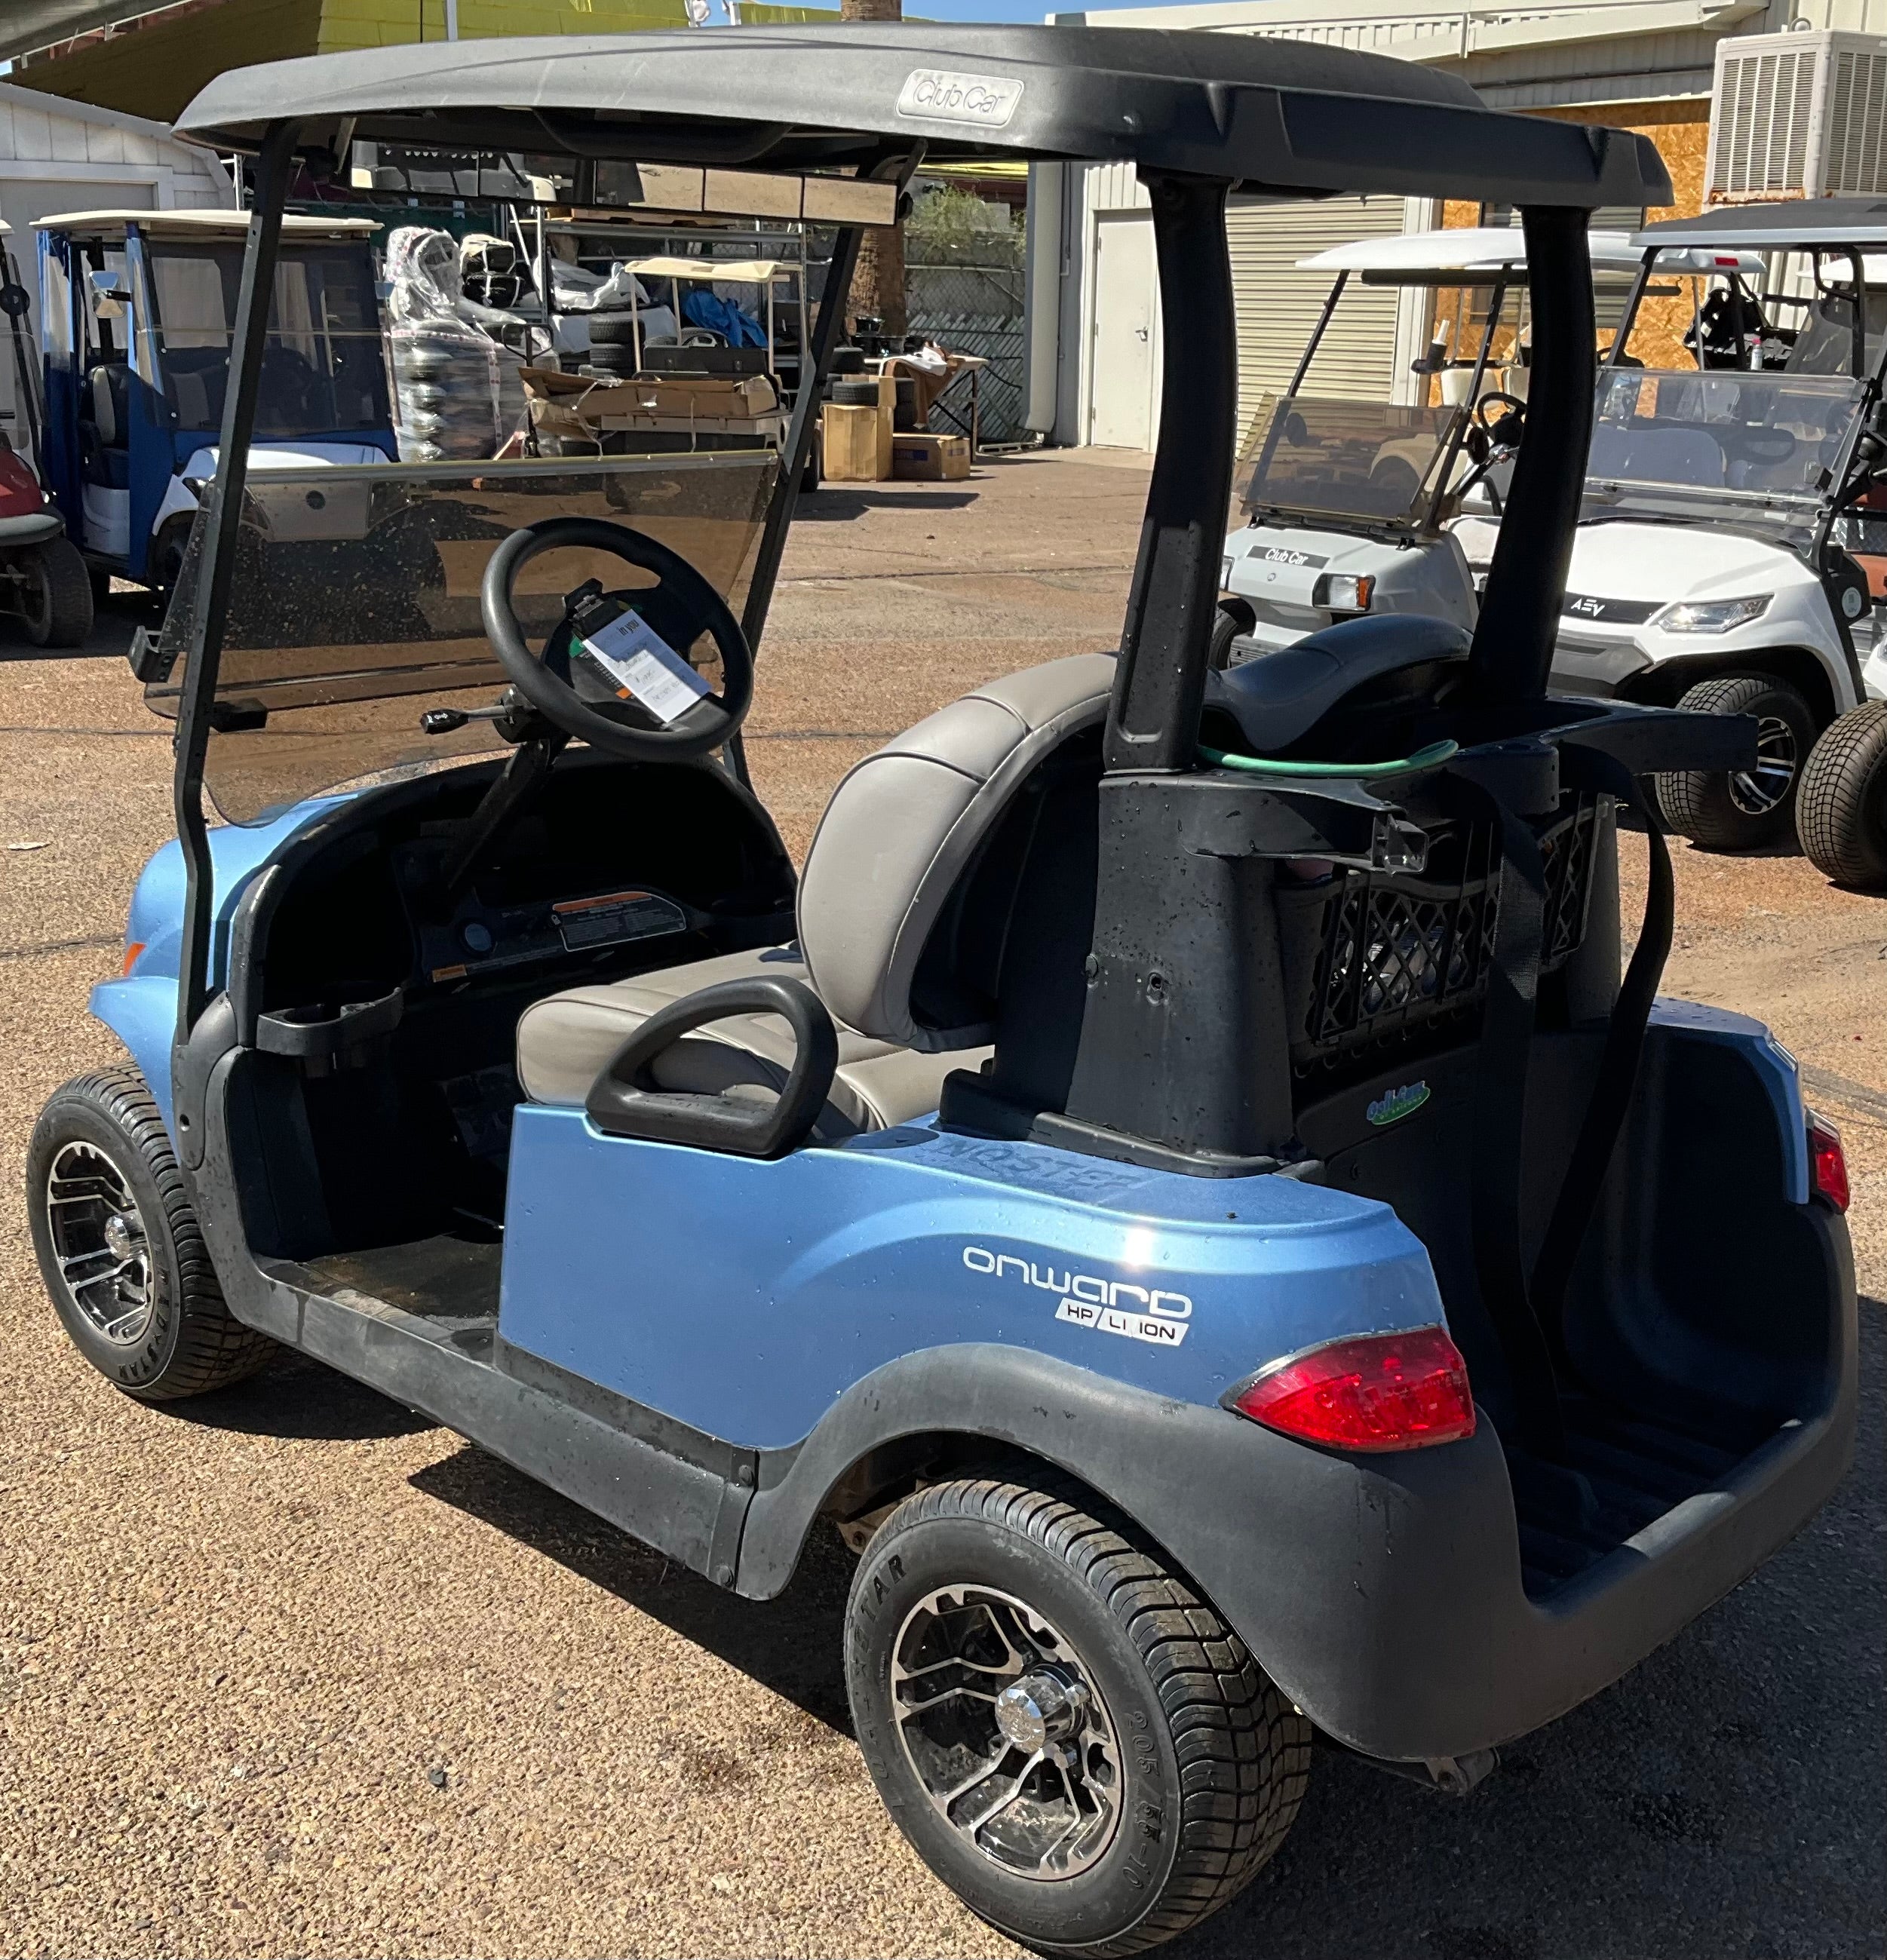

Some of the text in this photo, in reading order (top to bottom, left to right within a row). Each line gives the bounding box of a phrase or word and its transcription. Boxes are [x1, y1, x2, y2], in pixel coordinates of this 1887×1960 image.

[913, 79, 1007, 114] Club Car
[1265, 548, 1309, 566] Club Car
[1570, 597, 1606, 617] AEV
[1067, 1304, 1176, 1340] HP LI ION
